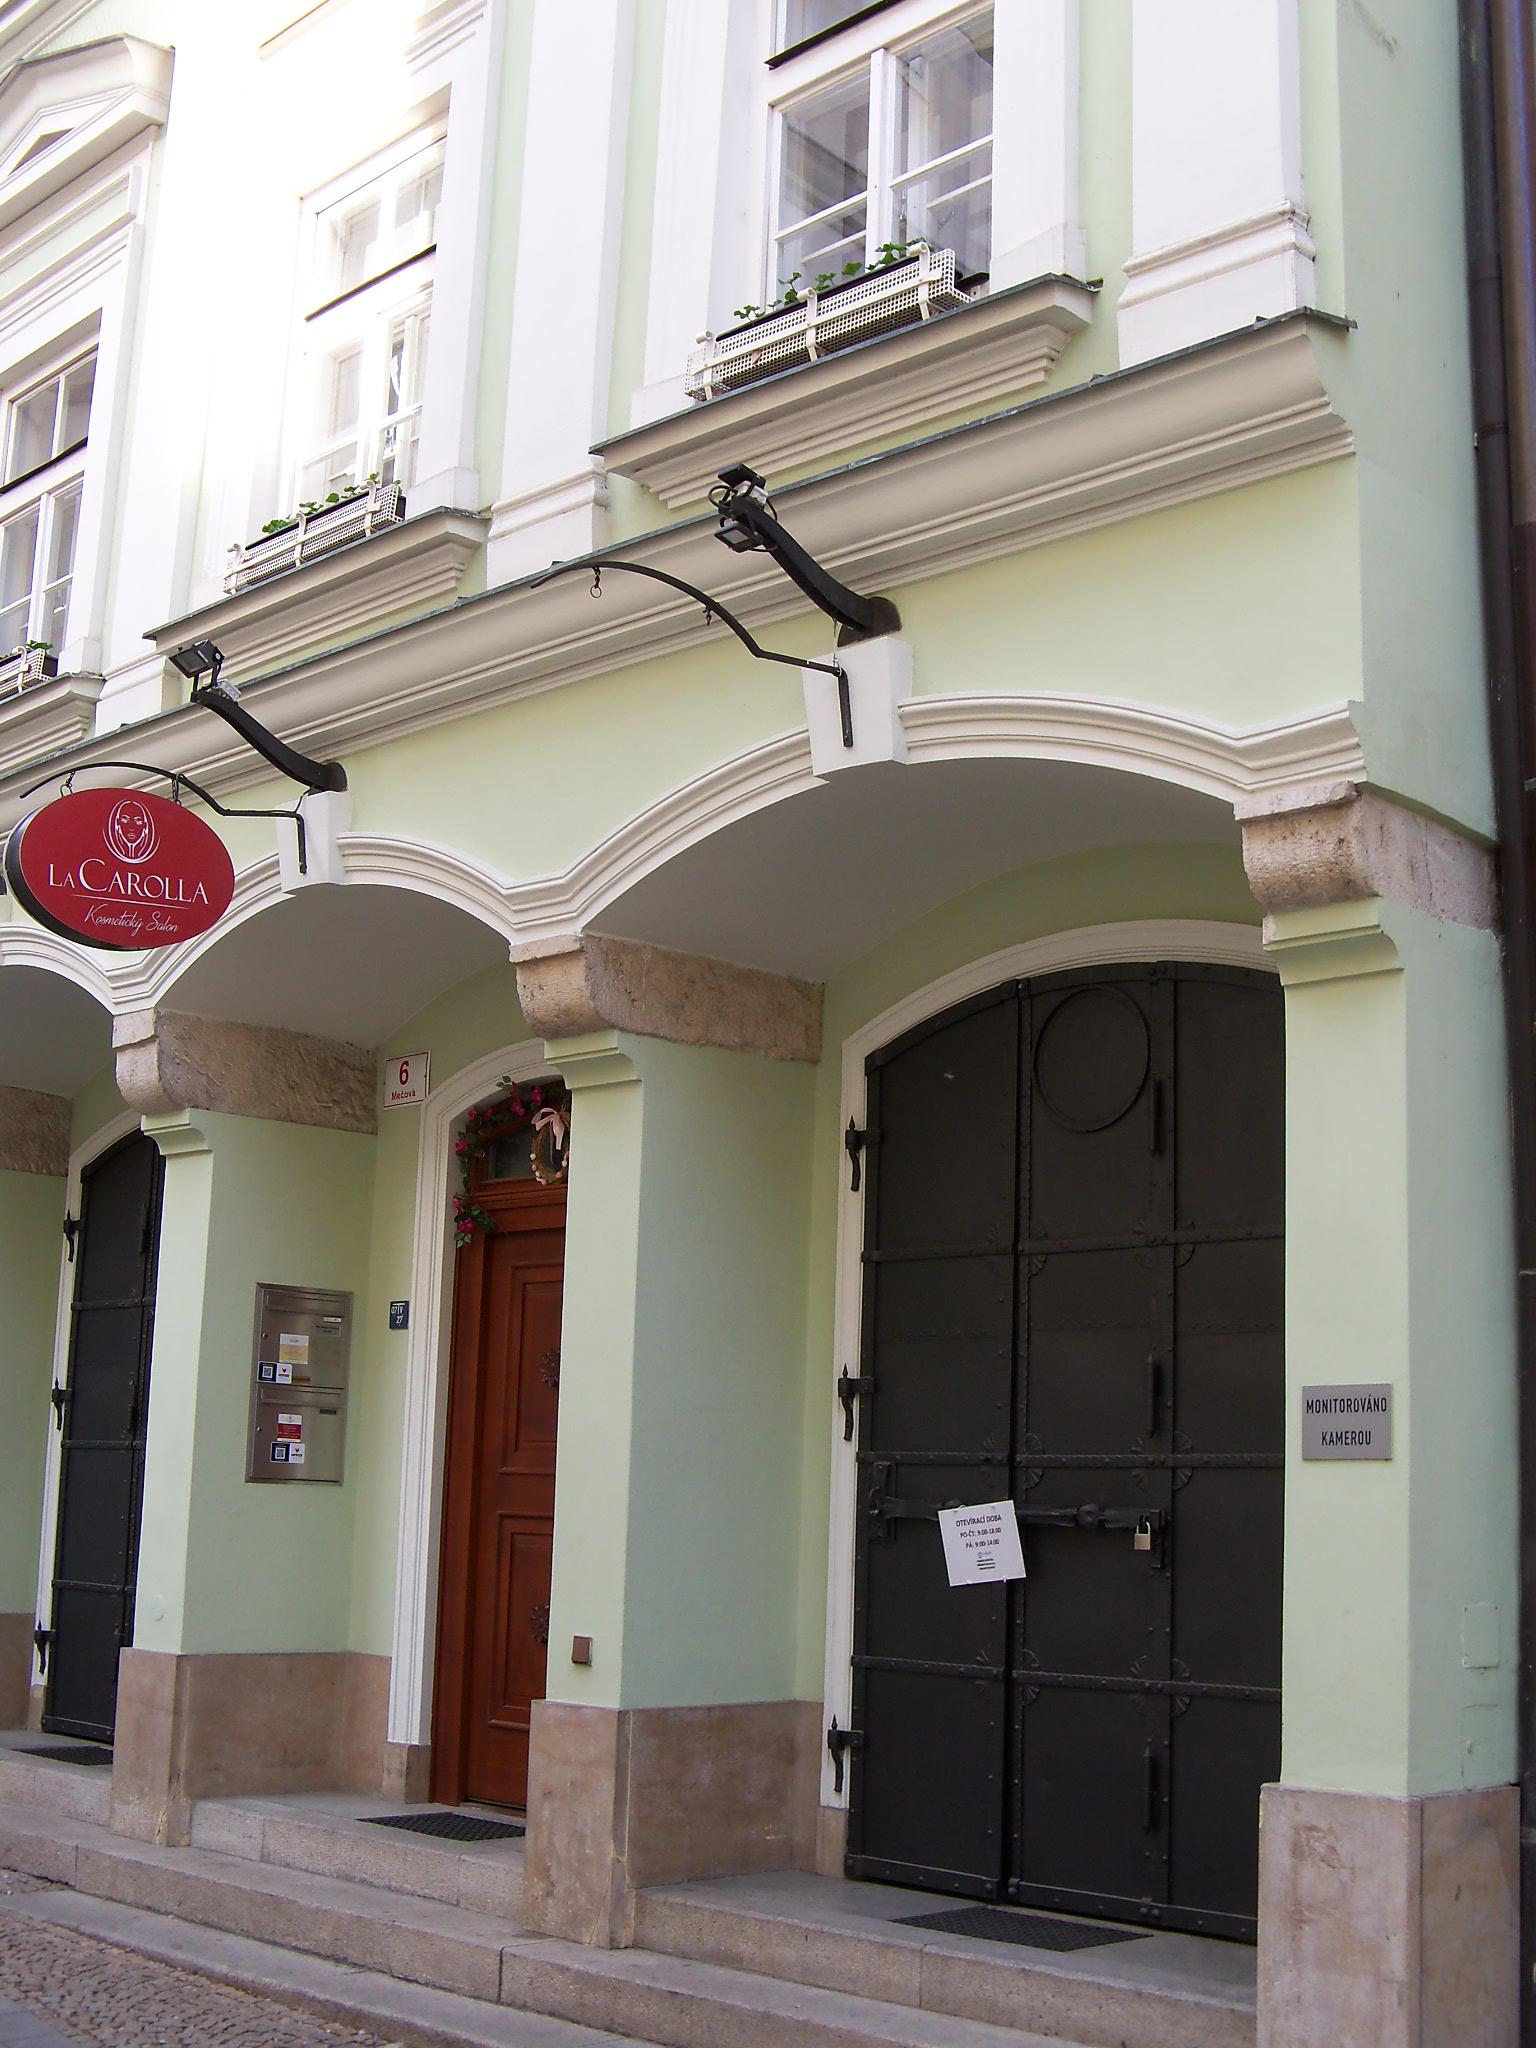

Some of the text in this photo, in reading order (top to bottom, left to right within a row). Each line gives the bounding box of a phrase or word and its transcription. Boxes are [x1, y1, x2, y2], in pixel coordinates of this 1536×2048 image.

[84, 904, 178, 936] Kosmetický Salon
[399, 1060, 409, 1085] 6
[391, 1089, 416, 1100] Mečová
[1306, 1394, 1387, 1414] MONITOROVÁNO
[1321, 1430, 1371, 1446] KAMEROU
[955, 1514, 1002, 1527] OTEVÍRACÍ DOBA
